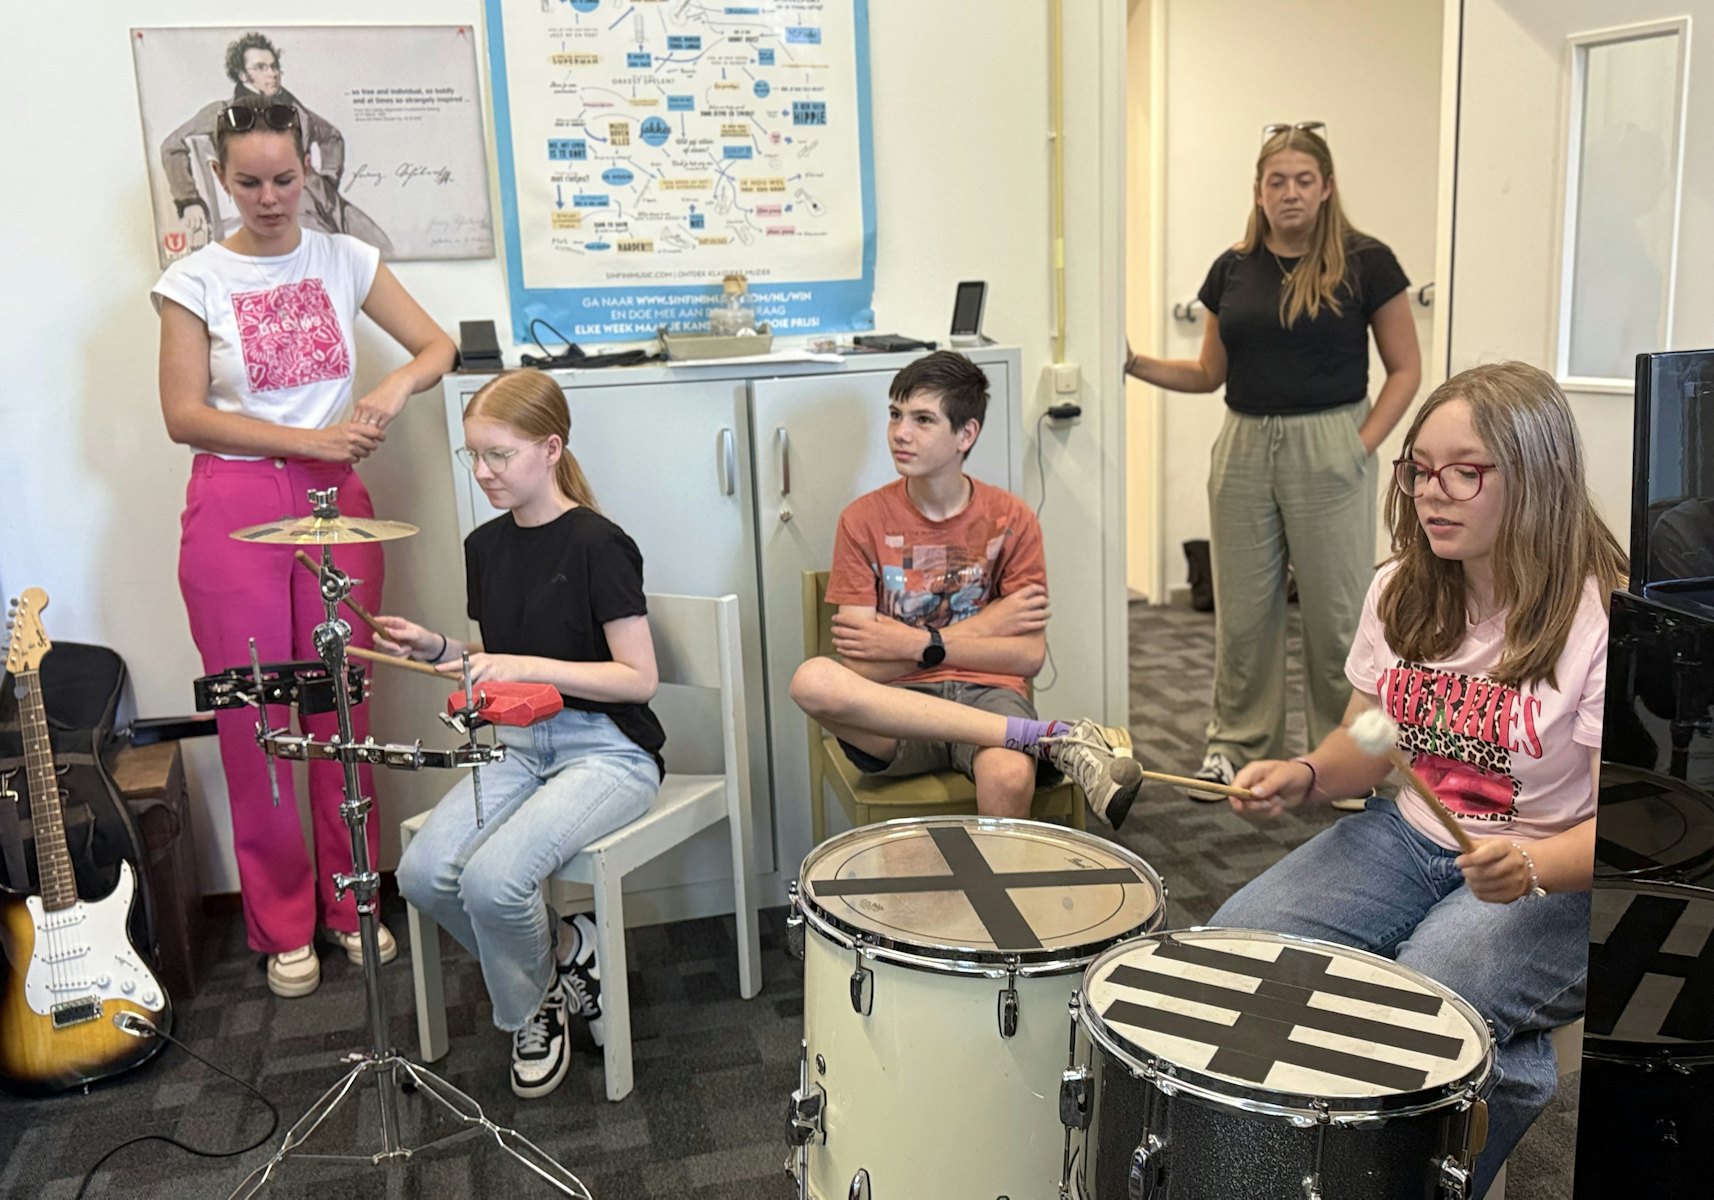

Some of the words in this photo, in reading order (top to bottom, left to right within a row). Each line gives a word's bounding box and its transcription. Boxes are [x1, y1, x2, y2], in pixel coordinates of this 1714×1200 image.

[435, 87, 454, 95] boldly
[437, 96, 462, 104] inspired
[793, 111, 826, 125] HIPPIE
[582, 297, 600, 308] GA
[602, 296, 633, 306] NAAR
[611, 310, 626, 320] EN
[628, 309, 651, 319] DOE
[654, 308, 676, 318] MEE
[678, 307, 700, 317] AAN
[575, 324, 600, 335] ELKE
[603, 323, 633, 333] WEEK
[670, 321, 681, 331] JE
[790, 317, 820, 327] PRIJS!
